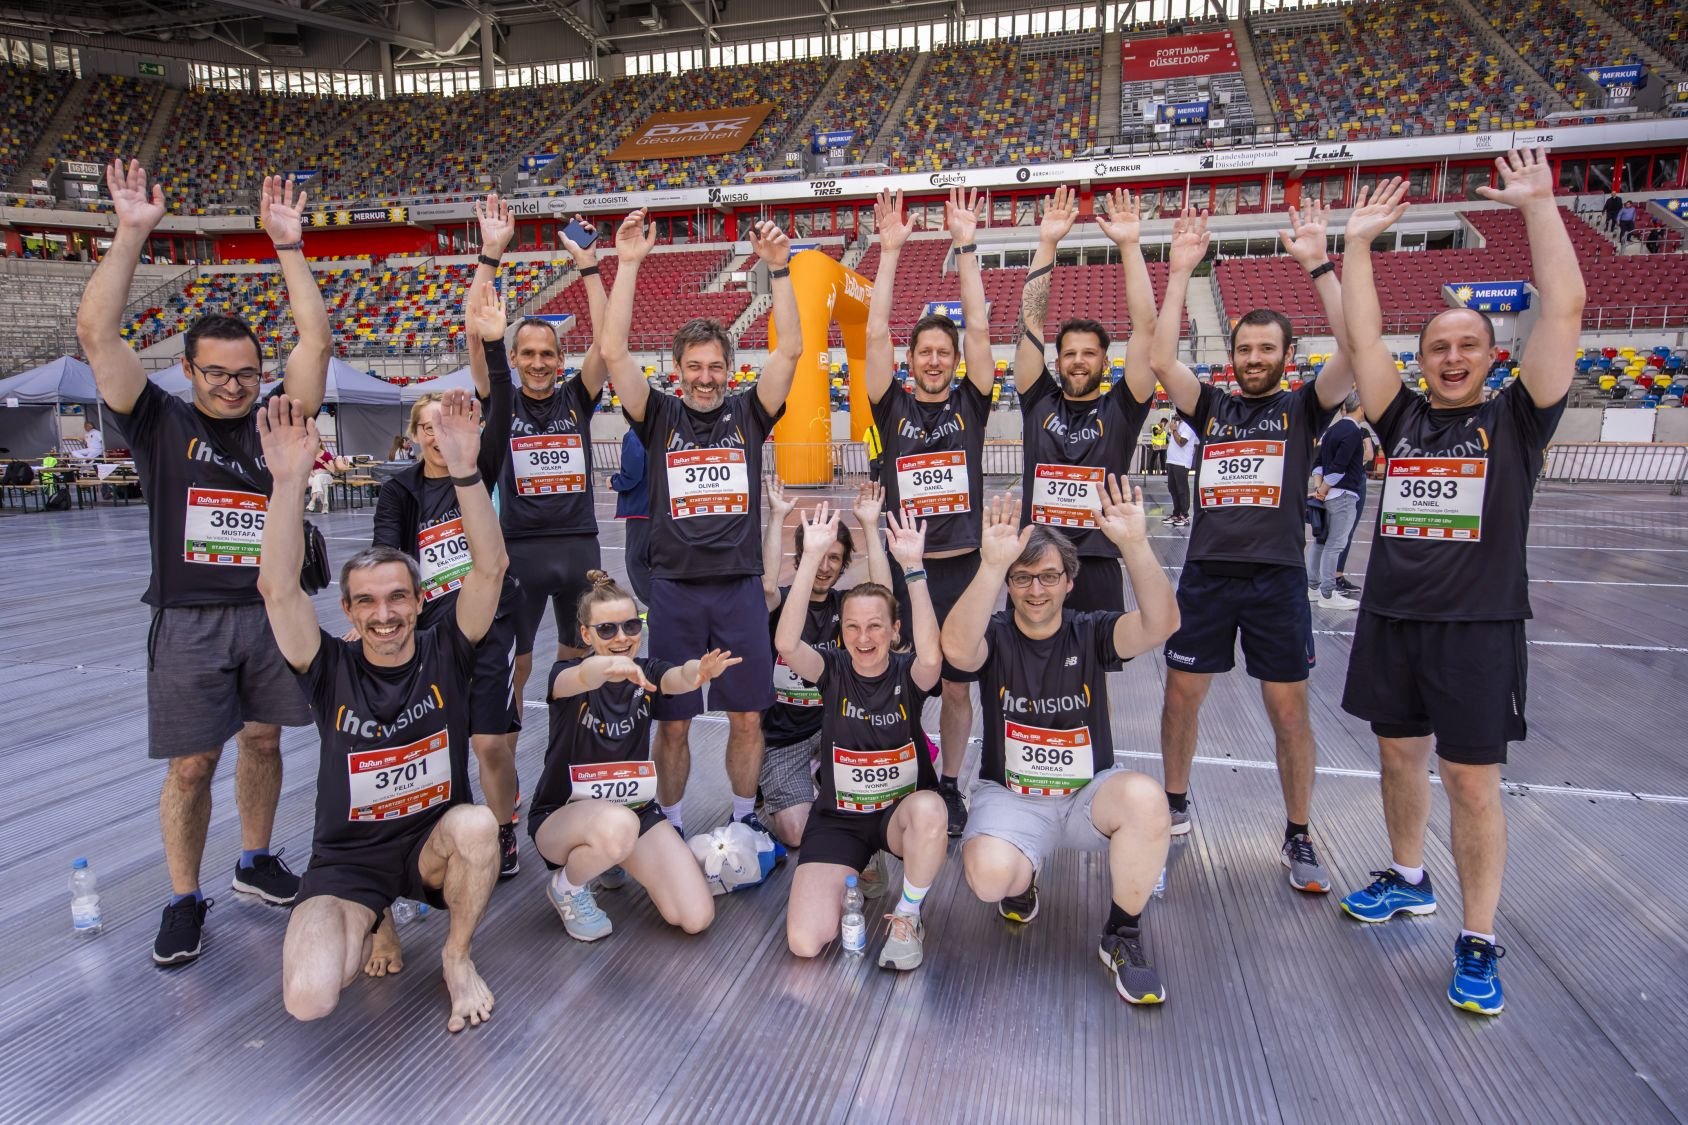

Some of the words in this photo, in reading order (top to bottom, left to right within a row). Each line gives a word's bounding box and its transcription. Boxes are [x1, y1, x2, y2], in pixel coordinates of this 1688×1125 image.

[1156, 46, 1198, 56] FORTUNA
[1149, 54, 1210, 68] DÜSSELDORF
[1602, 70, 1638, 79] MERKUR
[1612, 88, 1630, 96] 107
[644, 117, 752, 137] DAK
[636, 130, 742, 145] Gesundheit
[1215, 151, 1279, 161] Landeshauptstadt
[1109, 164, 1141, 172] MERKUR
[1215, 160, 1254, 168] Düsseldorf
[810, 180, 836, 188] TOYO
[930, 172, 966, 187] Carlsberg
[506, 200, 540, 214] enkel
[354, 211, 386, 220] MERKUR
[1476, 289, 1518, 298] MERKUR
[1500, 303, 1512, 312] 06
[529, 450, 570, 465] 3699
[1218, 458, 1264, 474] 3697
[685, 466, 731, 483] 3700
[913, 468, 953, 486] 3694
[1047, 481, 1088, 497] 3705
[1400, 480, 1458, 499] 3693
[210, 510, 265, 531] 3695
[221, 529, 256, 537] MUSTAFA
[424, 536, 469, 563] 3706
[437, 553, 467, 568] EKATERINA
[1022, 746, 1074, 765] 3696
[375, 758, 428, 790] 3701
[851, 766, 900, 782] 3698
[394, 782, 414, 792] FELIX
[591, 781, 639, 799] 3702
